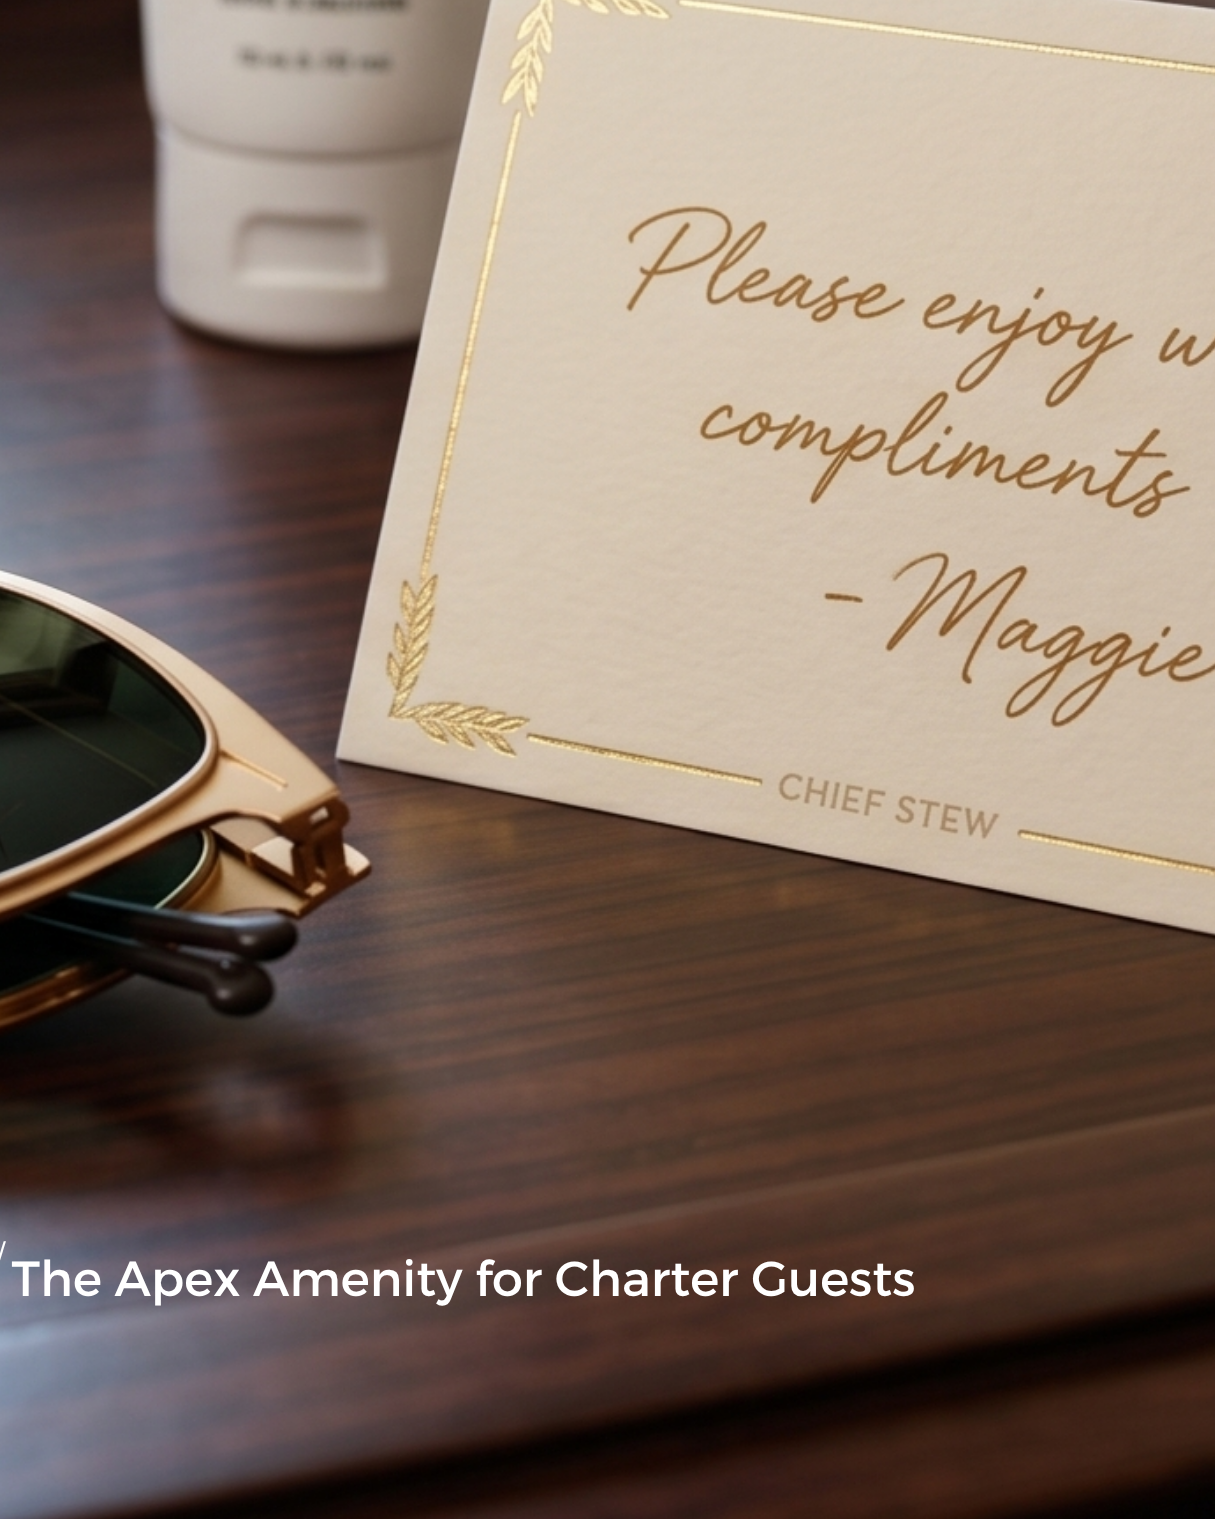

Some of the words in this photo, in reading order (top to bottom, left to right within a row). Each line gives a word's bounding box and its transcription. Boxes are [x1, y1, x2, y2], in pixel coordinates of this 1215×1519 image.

[628, 206, 905, 323] Please
[922, 287, 1134, 408] enjoy
[699, 391, 1191, 518] compliments
[887, 552, 1215, 727] Maggie
[778, 773, 886, 818] CHIEF
[894, 795, 1000, 840] STEW
